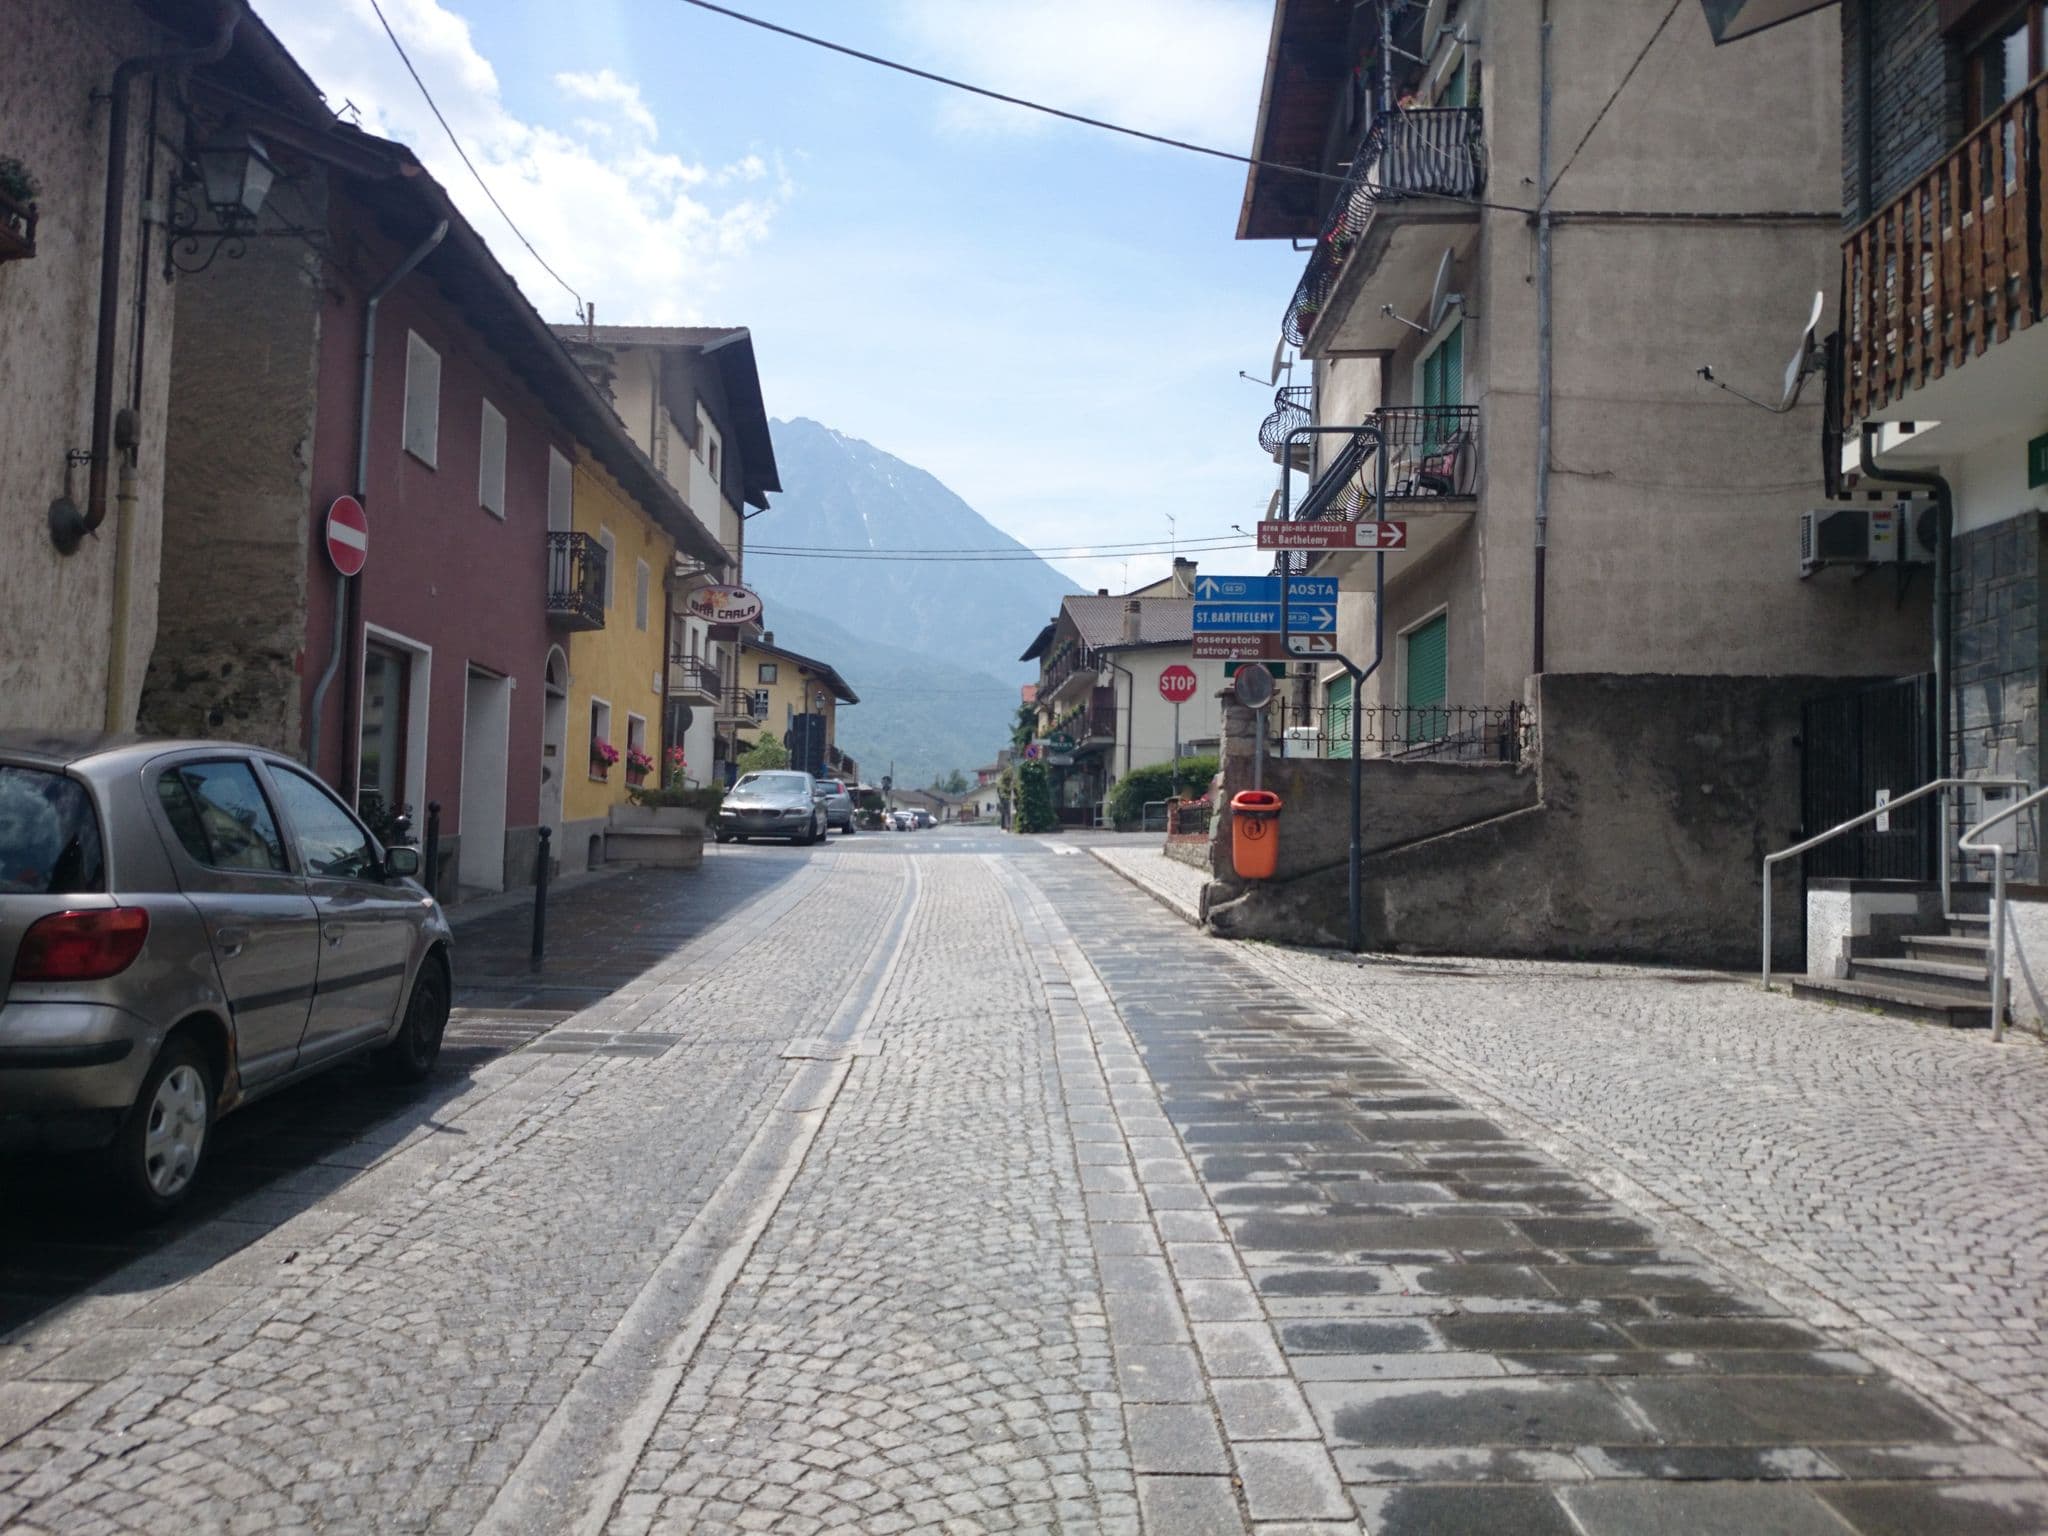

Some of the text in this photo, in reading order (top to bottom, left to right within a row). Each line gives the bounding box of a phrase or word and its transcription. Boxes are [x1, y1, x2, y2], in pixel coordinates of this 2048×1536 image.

[1281, 523, 1307, 533] pic-nic
[1309, 524, 1347, 532] attrezzata
[1262, 534, 1328, 546] St. Barthelemy
[1288, 584, 1334, 595] AOSTA
[691, 600, 756, 619] BAR CARLA
[1196, 635, 1261, 645] osservatorio
[1196, 646, 1259, 656] astronico
[1161, 676, 1195, 691] STOP
